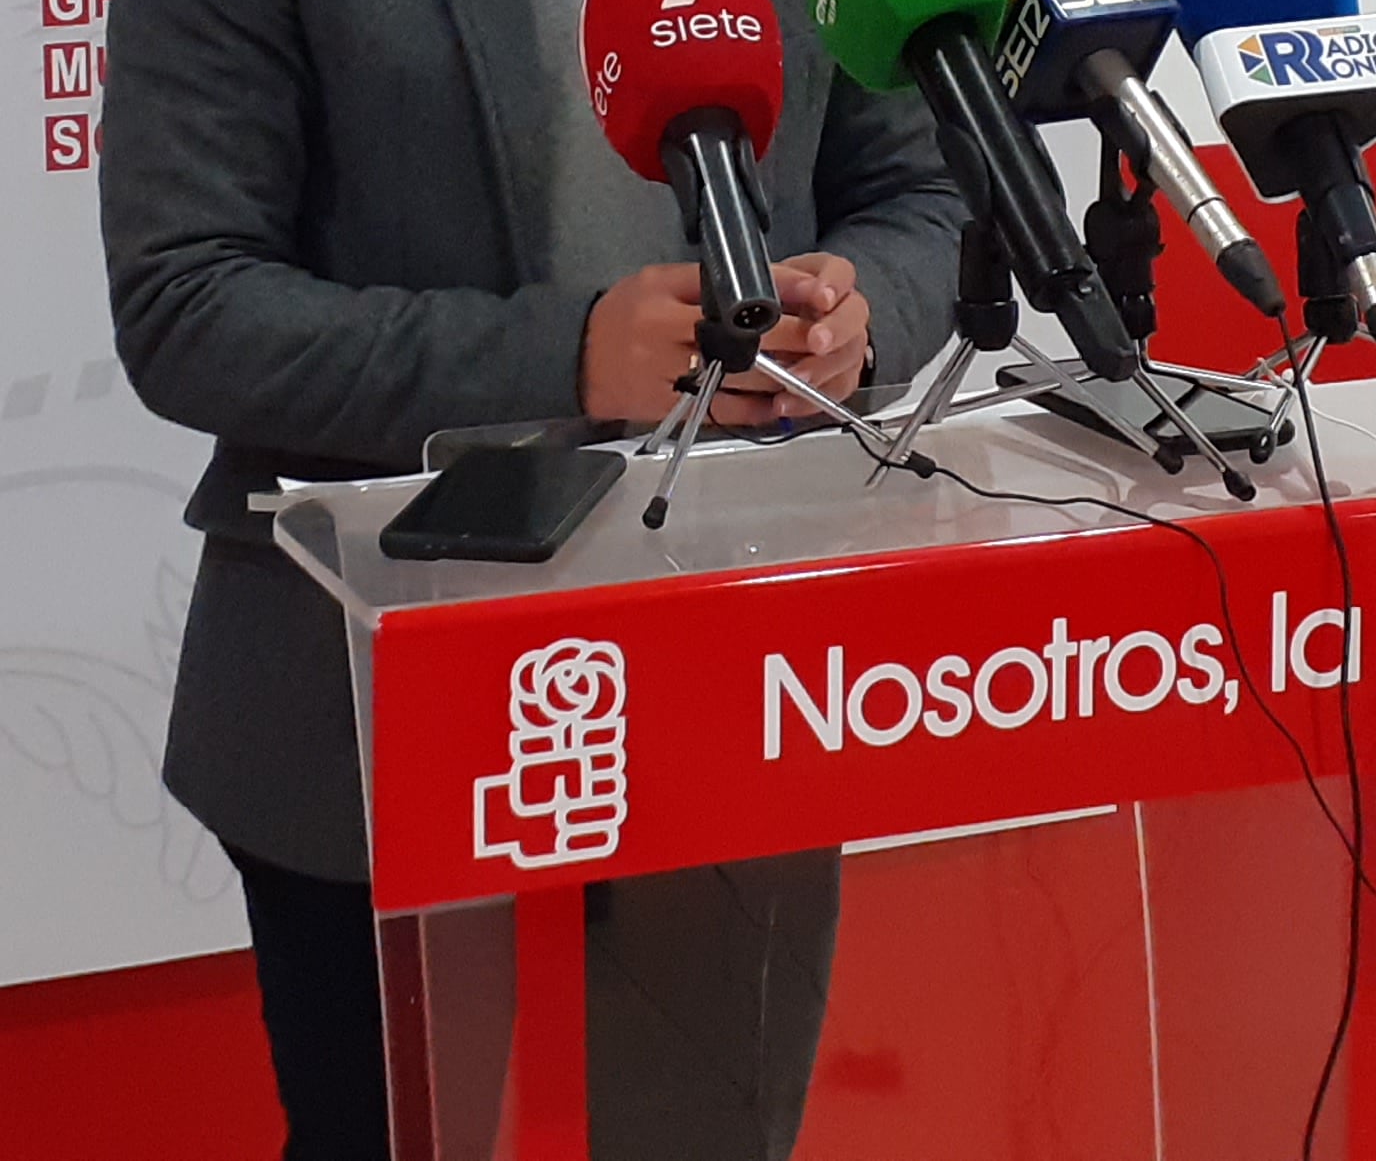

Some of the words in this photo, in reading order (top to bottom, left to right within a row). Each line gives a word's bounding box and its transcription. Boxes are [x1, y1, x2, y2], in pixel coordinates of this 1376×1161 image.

[650, 8, 762, 48] siete
[763, 617, 1239, 761] Nosotros,
[1271, 590, 1361, 693] la
